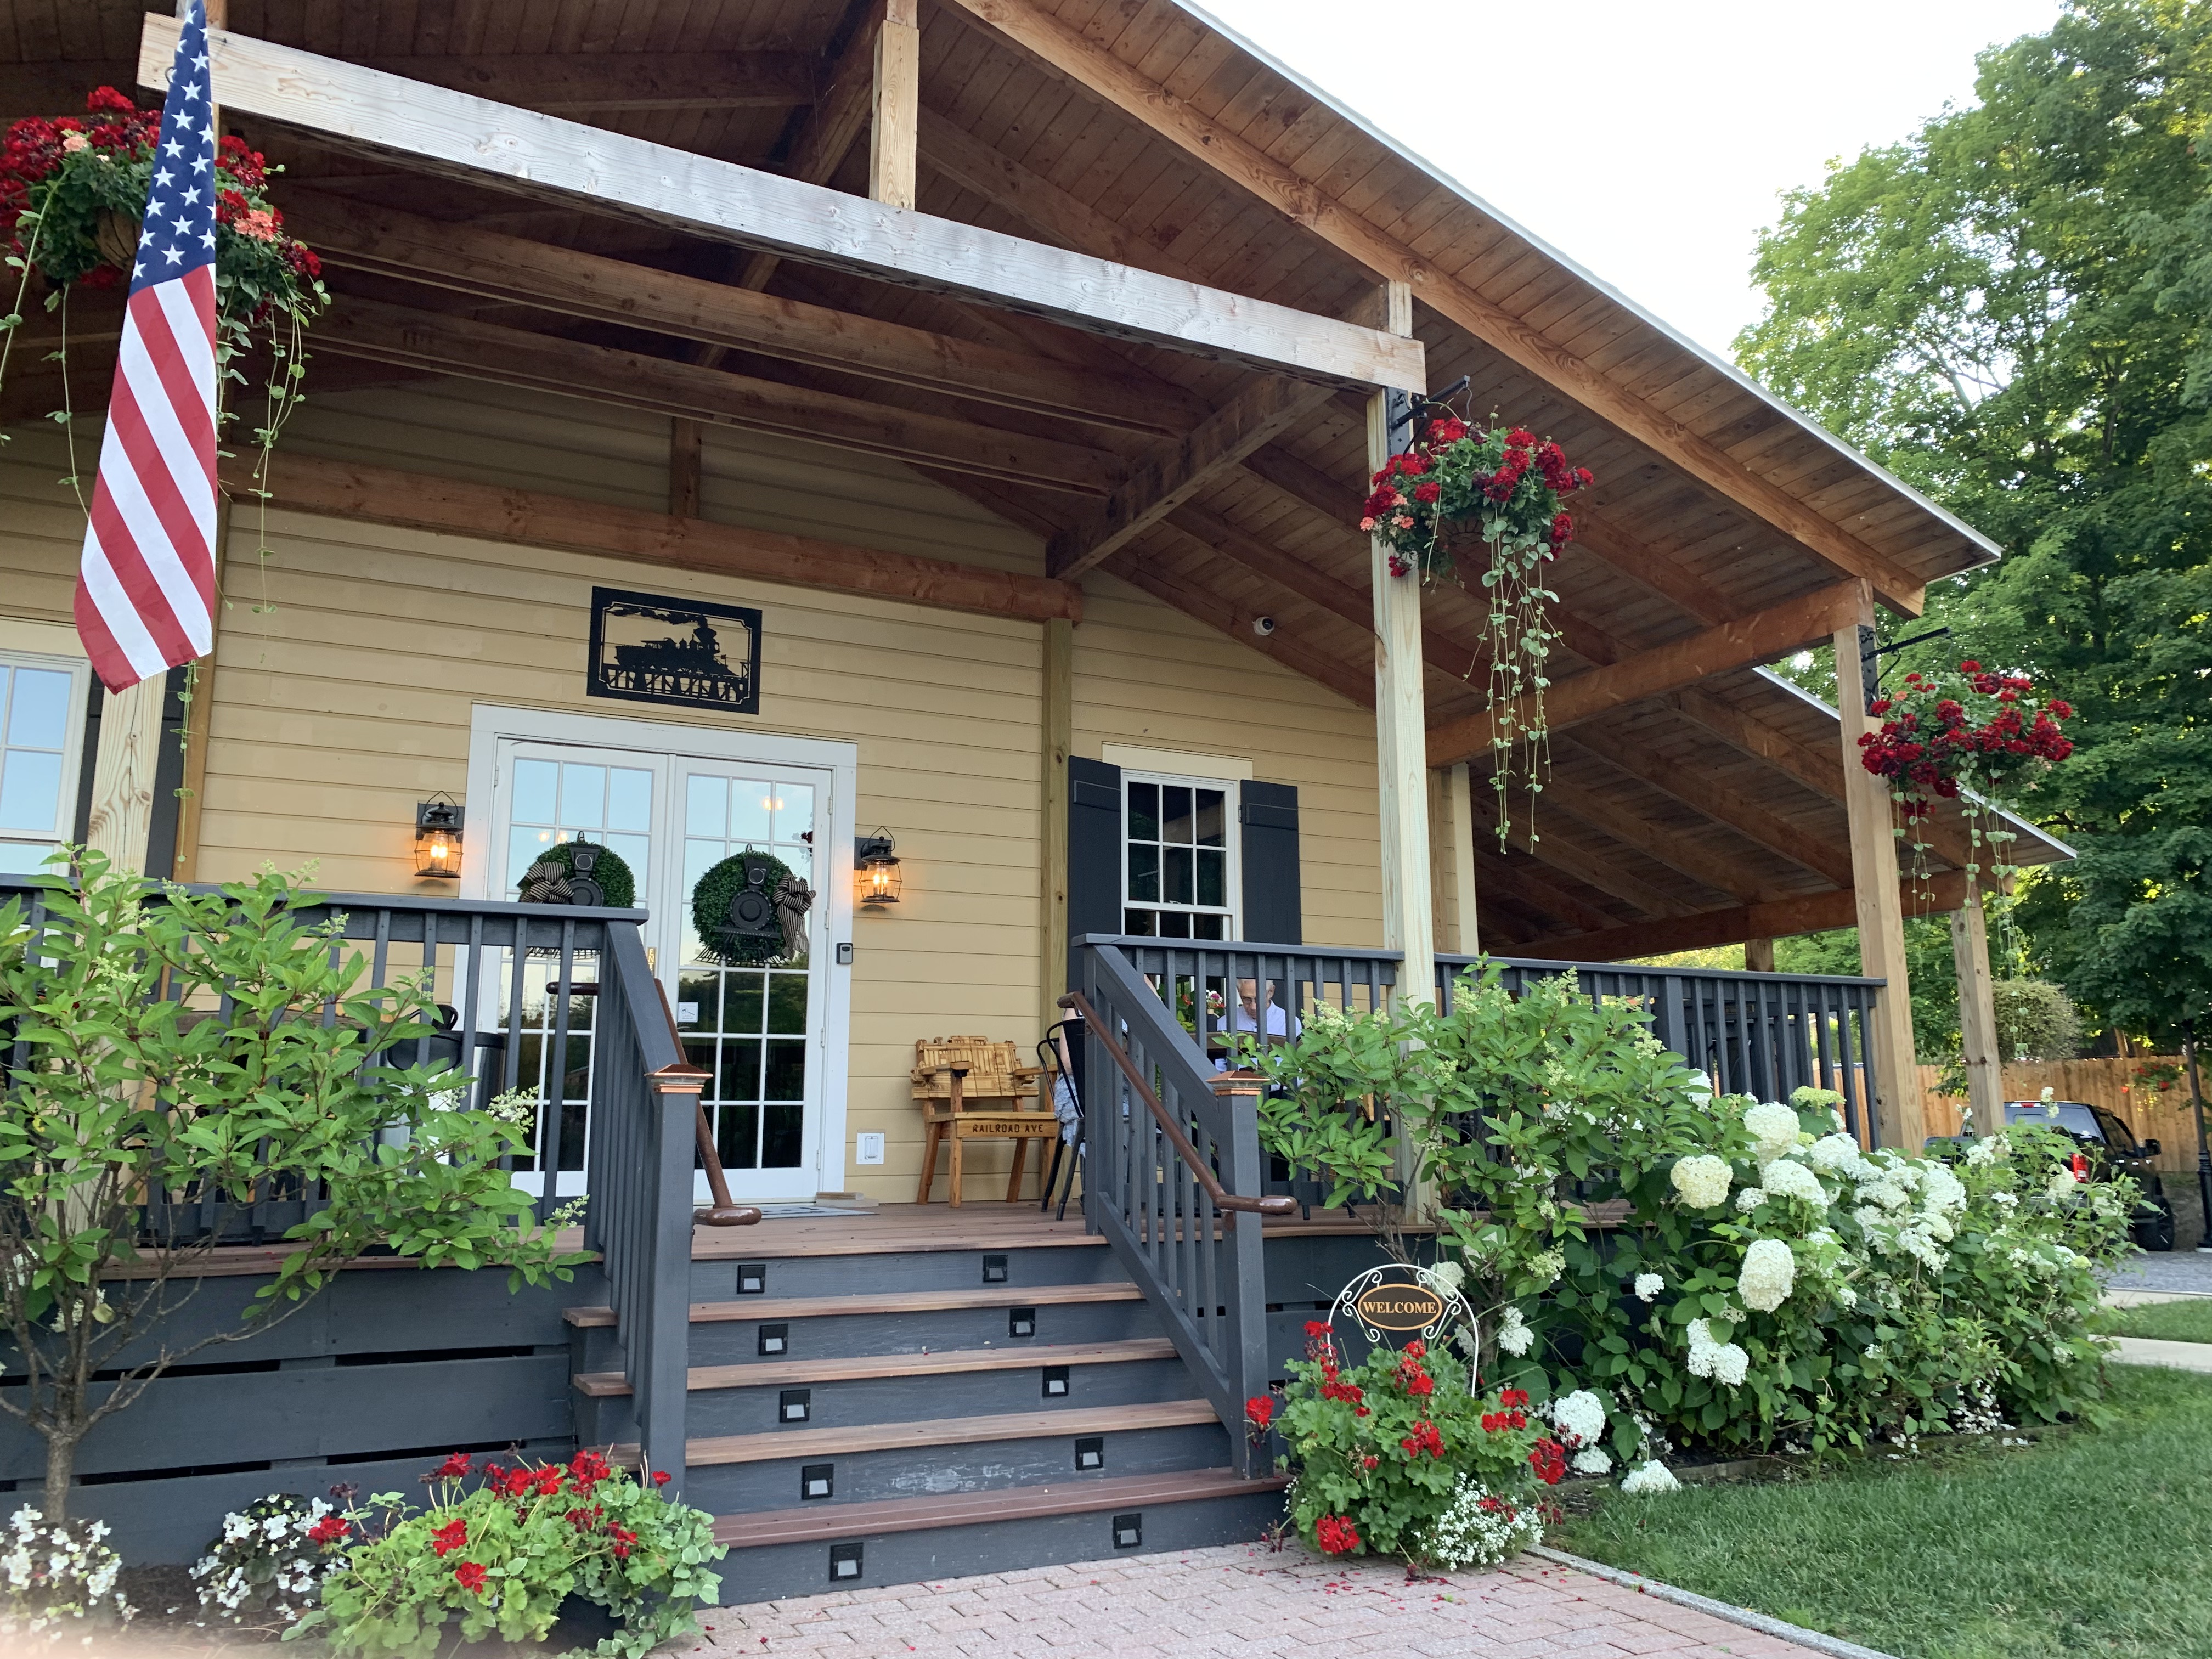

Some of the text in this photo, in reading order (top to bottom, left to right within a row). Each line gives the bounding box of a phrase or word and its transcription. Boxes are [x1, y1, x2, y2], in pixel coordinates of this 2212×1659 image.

[973, 1124, 1043, 1133] RAILROAD AVE
[1362, 1301, 1436, 1314] WELCOME
